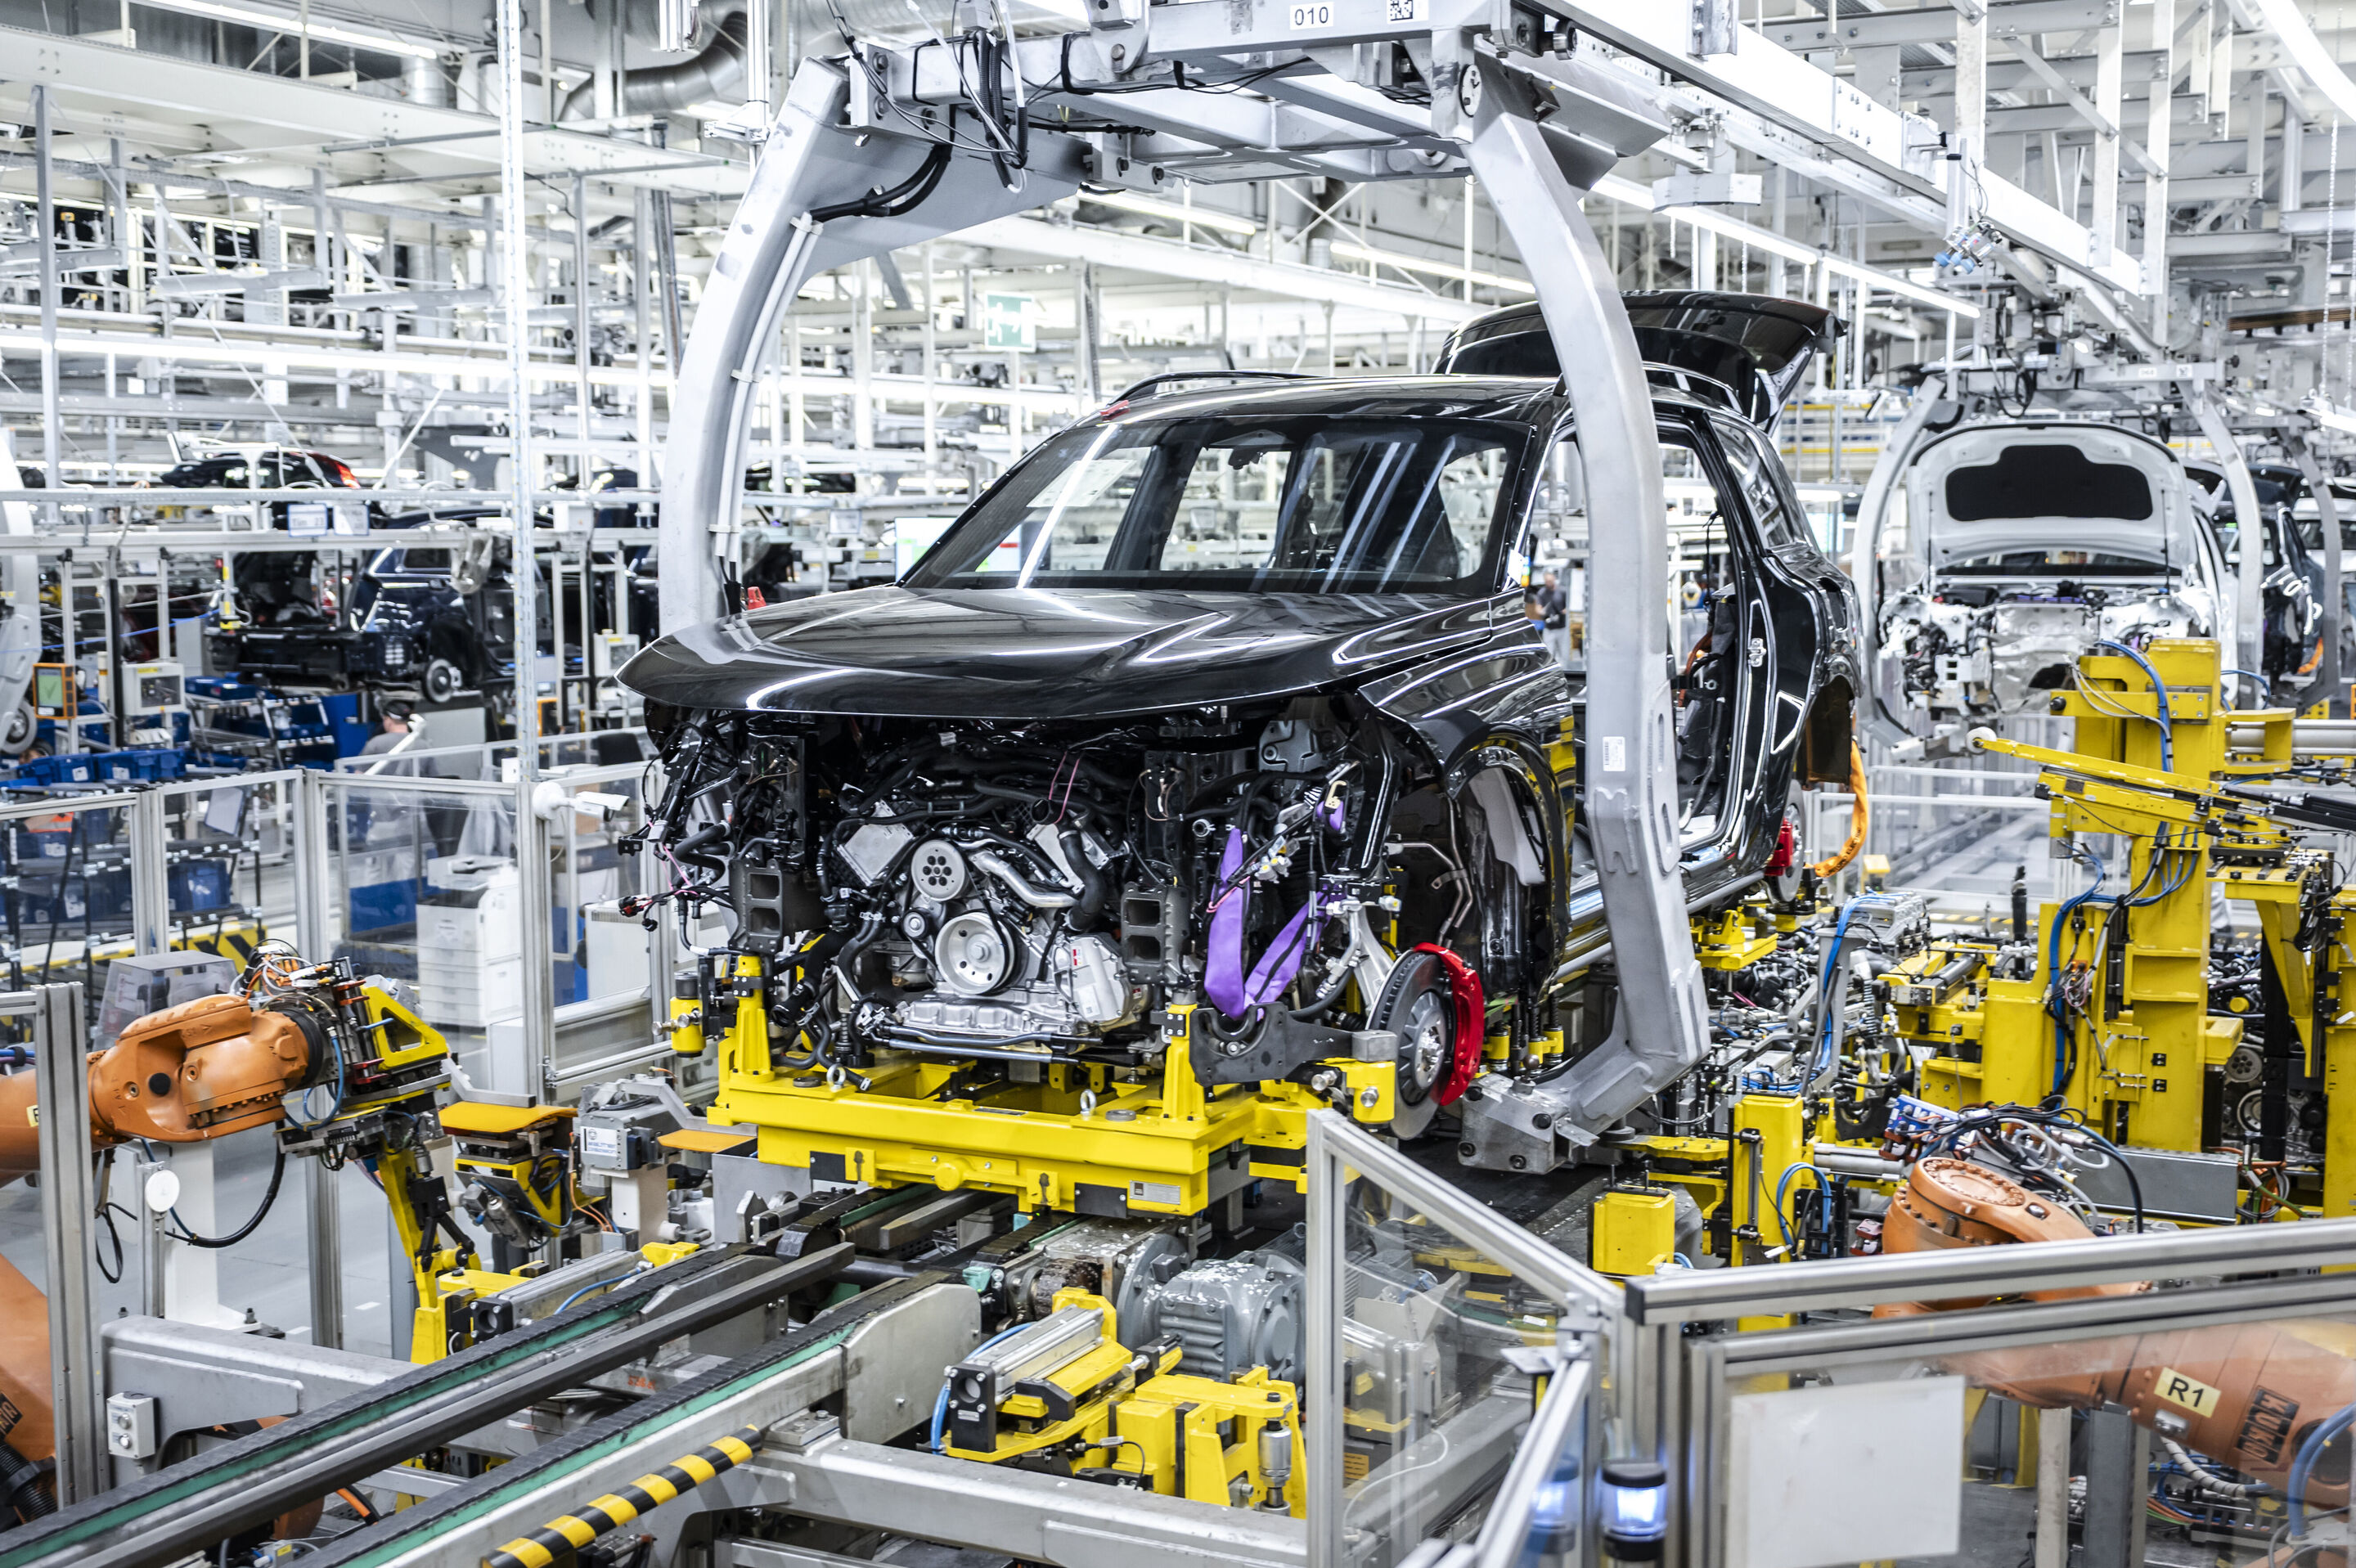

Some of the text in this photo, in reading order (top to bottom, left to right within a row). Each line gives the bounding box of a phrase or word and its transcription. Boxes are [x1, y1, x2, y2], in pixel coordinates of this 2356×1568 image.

[1294, 7, 1329, 25] 010
[2167, 1377, 2204, 1407] R1
[2242, 1392, 2293, 1460] KUKA
